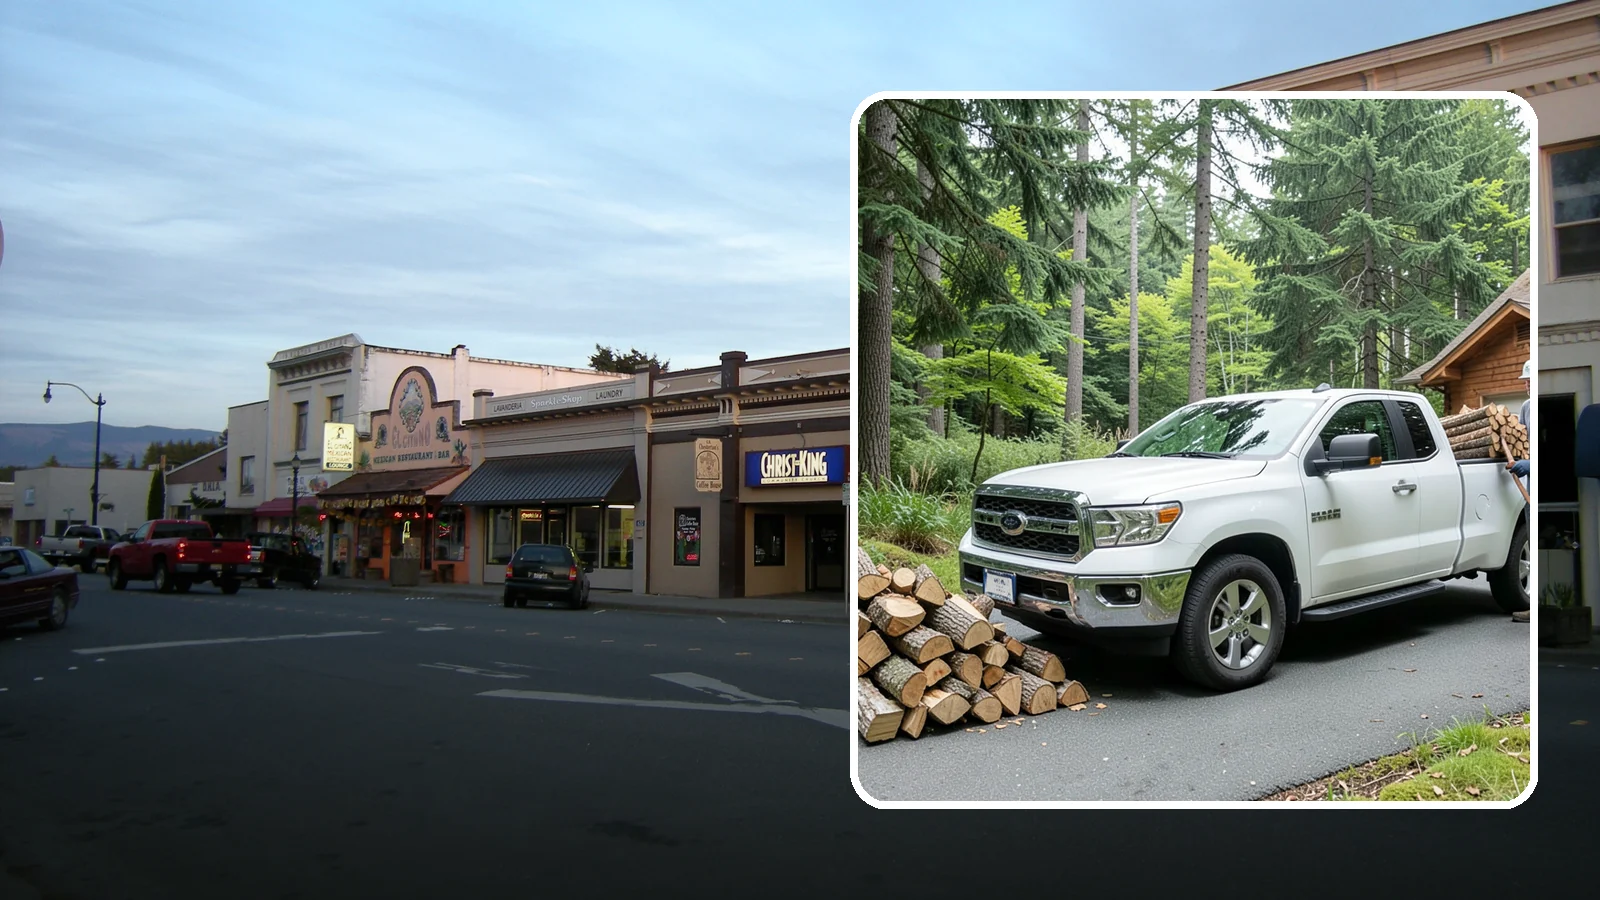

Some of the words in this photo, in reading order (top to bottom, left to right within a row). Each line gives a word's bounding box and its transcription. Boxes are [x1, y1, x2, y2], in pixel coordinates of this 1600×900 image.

[561, 395, 582, 405] Shop
[595, 389, 623, 400] LAUNDRY
[493, 402, 522, 412] LAVANDERIA
[373, 454, 396, 464] MEXICAN
[398, 451, 433, 462] RESTAURANT
[438, 450, 450, 458] BAR
[761, 452, 797, 478] CHRIST
[799, 450, 827, 476] KING
